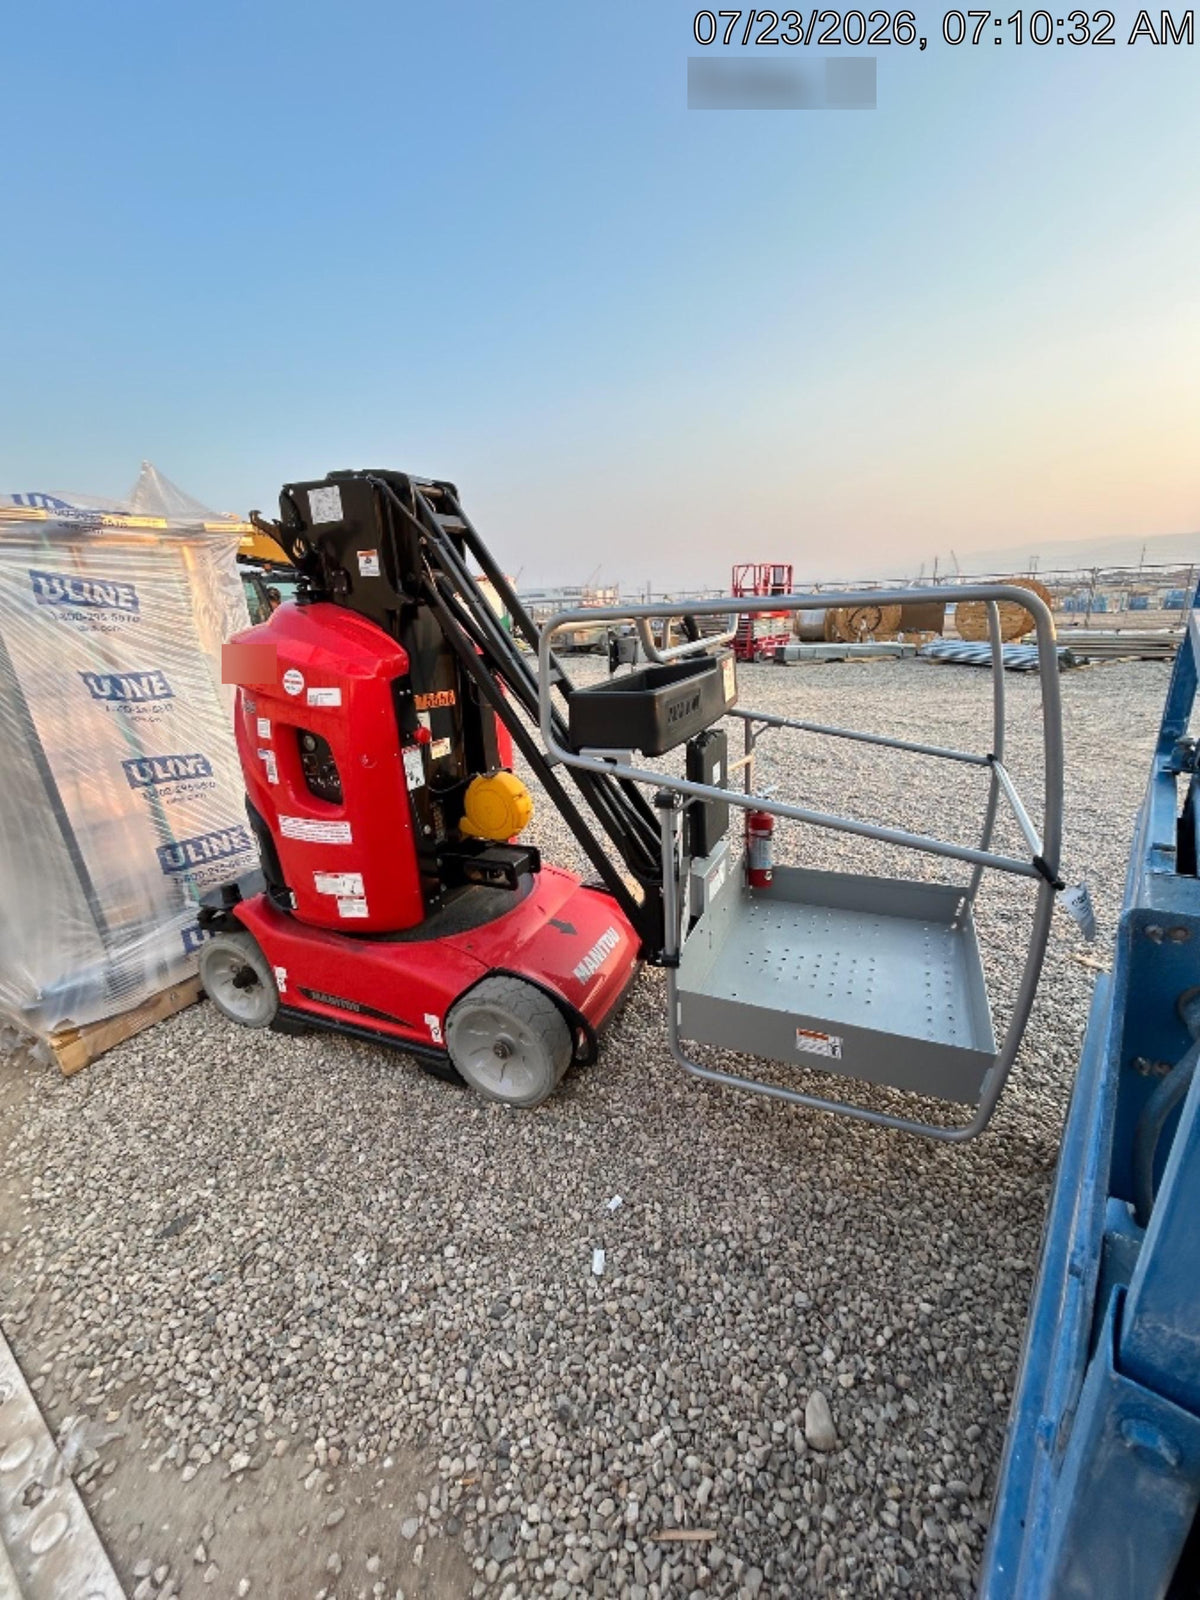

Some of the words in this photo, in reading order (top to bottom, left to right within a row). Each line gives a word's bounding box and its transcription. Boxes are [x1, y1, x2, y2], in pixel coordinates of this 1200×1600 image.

[34, 575, 136, 608] ULINE
[127, 756, 208, 782] ULINE
[572, 925, 621, 986] MANITOU
